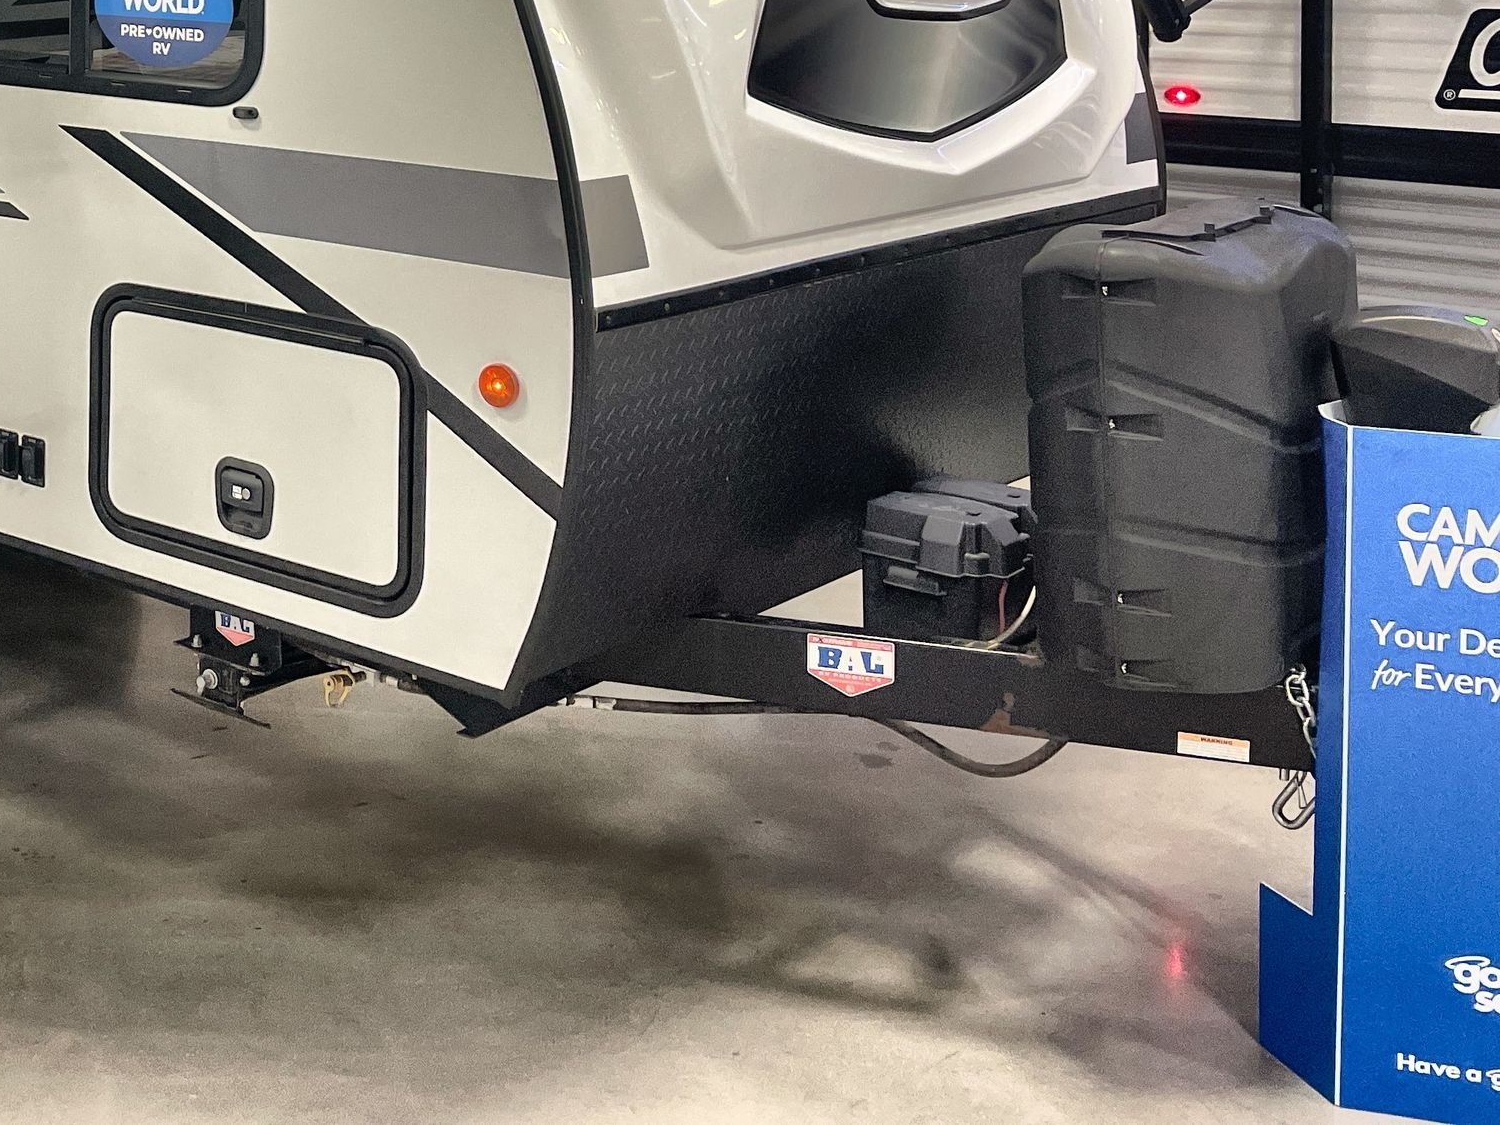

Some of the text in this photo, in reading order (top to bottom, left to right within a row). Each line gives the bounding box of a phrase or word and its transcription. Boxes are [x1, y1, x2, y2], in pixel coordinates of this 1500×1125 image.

[152, 42, 171, 55] RV
[1398, 540, 1500, 595] WO
[1370, 619, 1450, 652] Your
[817, 646, 884, 674] BAL
[1371, 659, 1412, 690] for
[1396, 1052, 1461, 1080] Have
[1465, 1068, 1482, 1083] a
